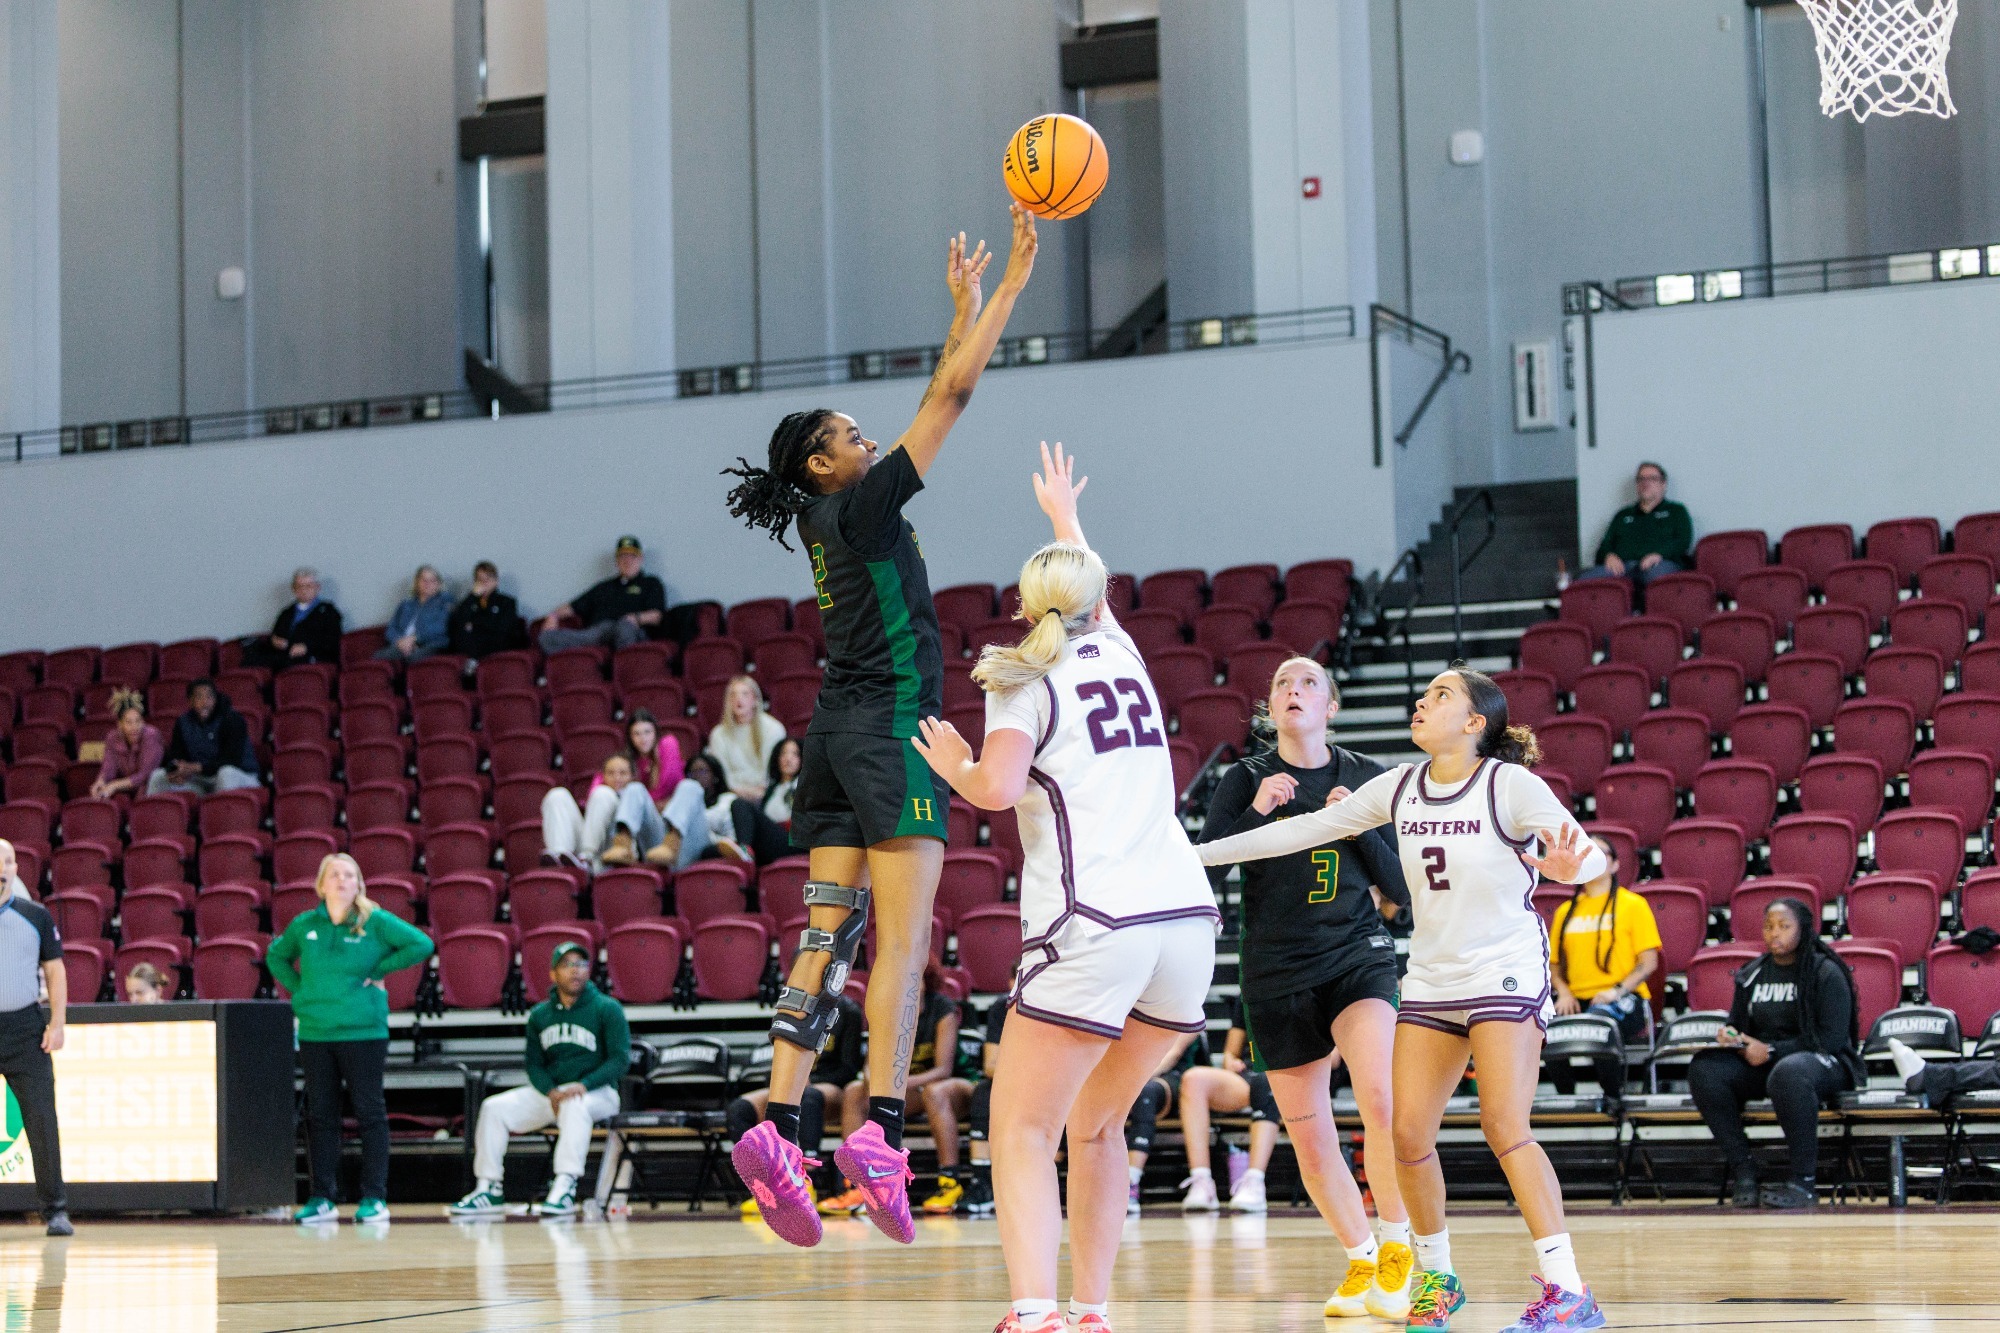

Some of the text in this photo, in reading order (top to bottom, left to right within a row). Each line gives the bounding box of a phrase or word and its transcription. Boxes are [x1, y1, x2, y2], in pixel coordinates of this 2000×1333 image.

[1079, 650, 1099, 659] MAC
[1075, 677, 1164, 755] 22
[912, 798, 934, 821] H
[1401, 819, 1481, 836] EASTERN
[1308, 850, 1339, 903] 3
[1421, 846, 1451, 890] 2
[1879, 1016, 1949, 1038] ROANOKE
